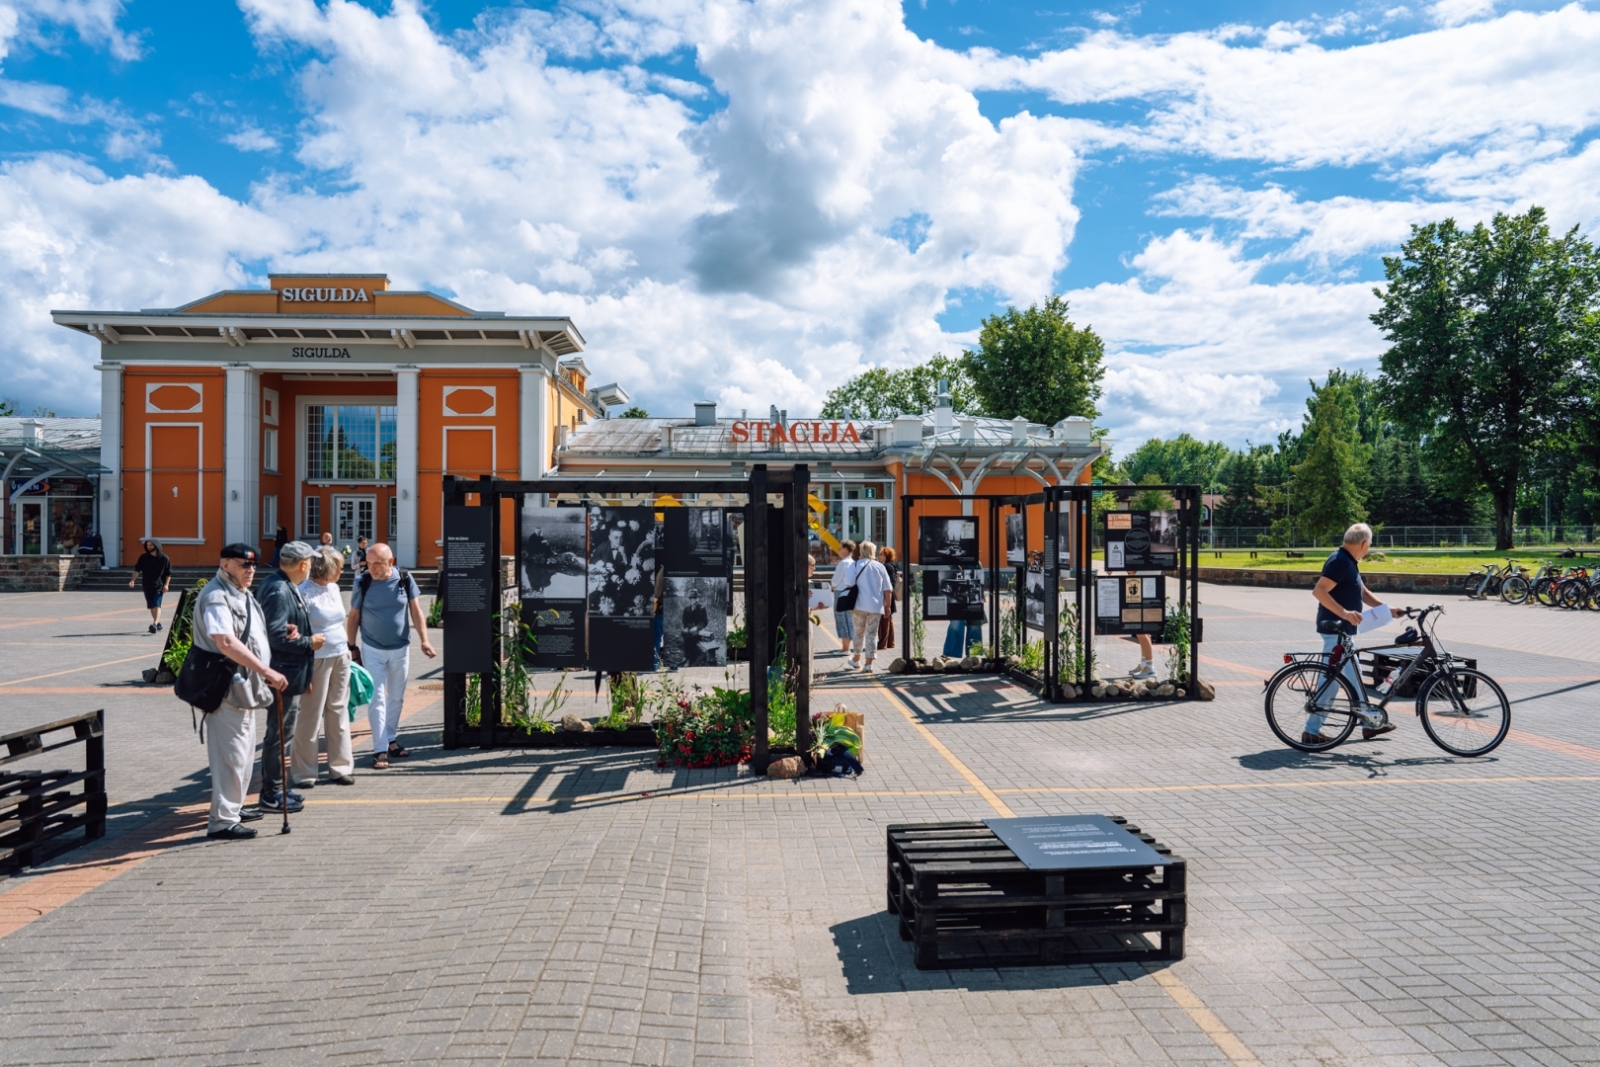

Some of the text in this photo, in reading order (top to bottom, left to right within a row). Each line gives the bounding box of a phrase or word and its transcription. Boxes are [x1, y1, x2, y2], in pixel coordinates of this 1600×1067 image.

[282, 287, 369, 302] SIGULDA
[292, 347, 351, 358] SIGULDA
[731, 421, 861, 444] STACIJA
